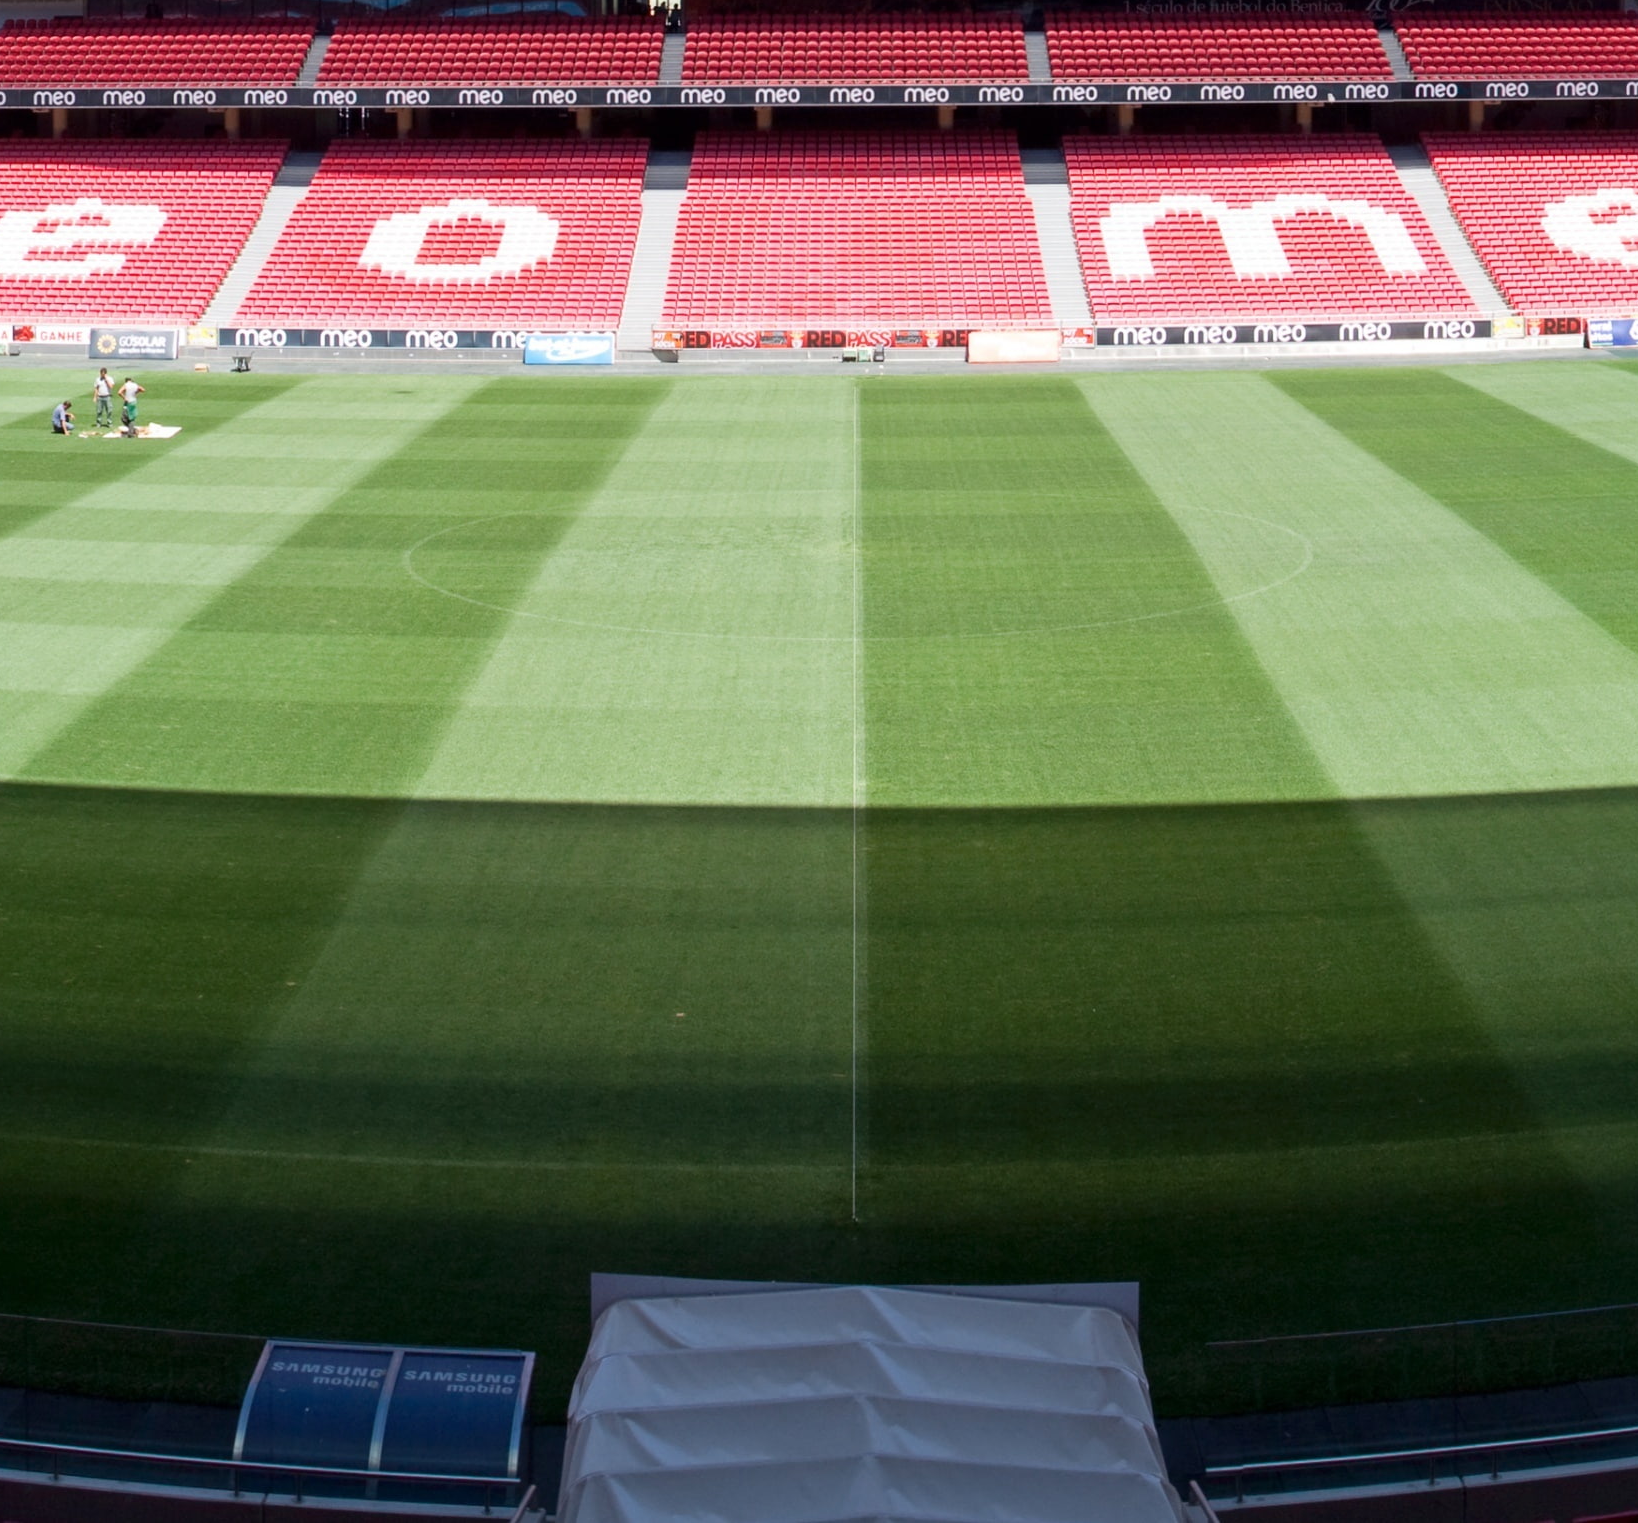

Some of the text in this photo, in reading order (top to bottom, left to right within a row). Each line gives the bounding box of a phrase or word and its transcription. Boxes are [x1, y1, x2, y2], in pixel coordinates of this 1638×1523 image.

[681, 89, 725, 103] meo
[1184, 326, 1237, 344] meo
[1254, 324, 1306, 342] meo
[1339, 323, 1392, 340] meo
[1423, 321, 1475, 339] meo
[1543, 318, 1581, 335] RED
[40, 331, 83, 342] GANHE
[235, 329, 287, 346] meo
[320, 330, 373, 347] meo
[405, 330, 458, 349] meo
[712, 330, 757, 348] PASS
[807, 331, 892, 348] RED PASS
[1113, 327, 1167, 345] meo
[272, 1360, 385, 1379] SAMSUNG
[404, 1369, 517, 1385] SAMSUNG
[313, 1373, 379, 1390] mobile
[447, 1382, 514, 1396] mobile
